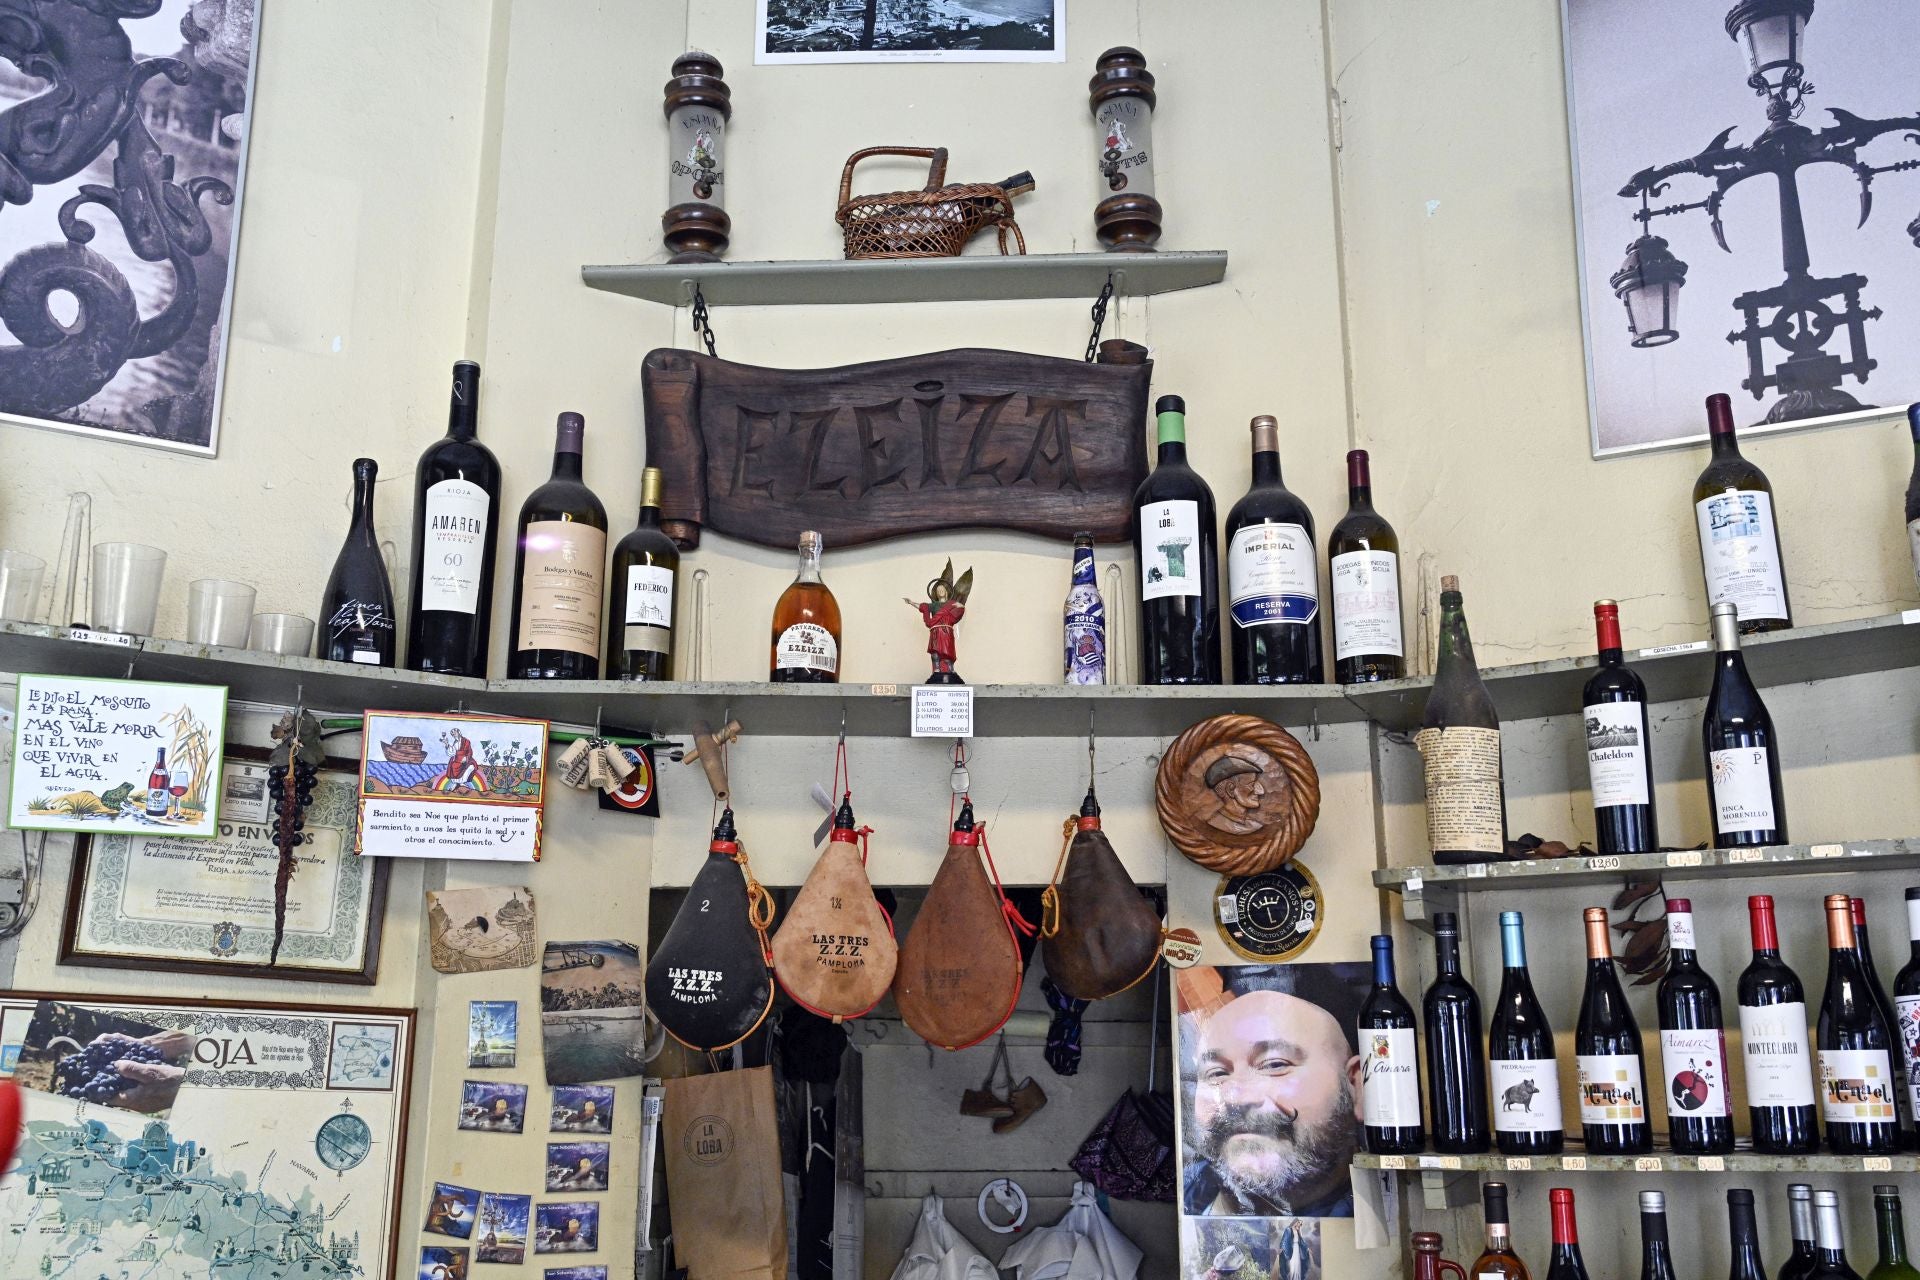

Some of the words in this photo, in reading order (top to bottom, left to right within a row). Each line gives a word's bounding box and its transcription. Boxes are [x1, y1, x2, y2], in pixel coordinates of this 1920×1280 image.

[1163, 508, 1170, 516] LA
[432, 515, 481, 535] AMAREN
[1245, 543, 1295, 555] IMPERIAL
[443, 553, 463, 567] 60
[634, 583, 668, 595] FEDERICO
[1255, 601, 1291, 610] RESERVA
[1074, 615, 1095, 623] 2010
[788, 645, 825, 655] EZEIZA
[29, 689, 41, 702] LE
[44, 691, 65, 704] DIJO
[66, 690, 87, 705] EL
[90, 695, 151, 711] MOSQUITO
[27, 703, 38, 711] A
[41, 703, 55, 715] LA
[69, 718, 108, 734] VALE
[111, 723, 166, 739] MORIR
[23, 734, 44, 747] EN
[49, 736, 71, 748] EL
[74, 737, 104, 749] VINO
[23, 750, 51, 765] QUE
[56, 751, 102, 768] VIVIR
[102, 752, 119, 763] EN
[1590, 749, 1634, 763] Chateldon
[40, 764, 61, 778] EL
[1722, 804, 1744, 812] FINCA
[373, 809, 406, 819] Bendito
[444, 813, 459, 823] que
[492, 815, 500, 823] el
[502, 815, 530, 826] primer
[1723, 810, 1768, 820] MORENILLO
[238, 828, 260, 840] EN
[446, 825, 457, 833] les
[485, 827, 492, 835] la
[495, 827, 508, 836] sed
[404, 836, 425, 844] otros
[428, 836, 436, 844] el
[195, 854, 225, 867] Experto
[700, 899, 711, 912] 2
[813, 934, 835, 944] LAS
[839, 935, 869, 946] TRES
[816, 955, 865, 969] PAMPLONA
[668, 967, 689, 979] LAS
[691, 969, 723, 982] TRES
[670, 989, 718, 1004] PAMPLONA
[703, 1124, 714, 1137] LA
[696, 1139, 722, 1155] LOBA
[290, 1159, 319, 1181] NAVARRA
